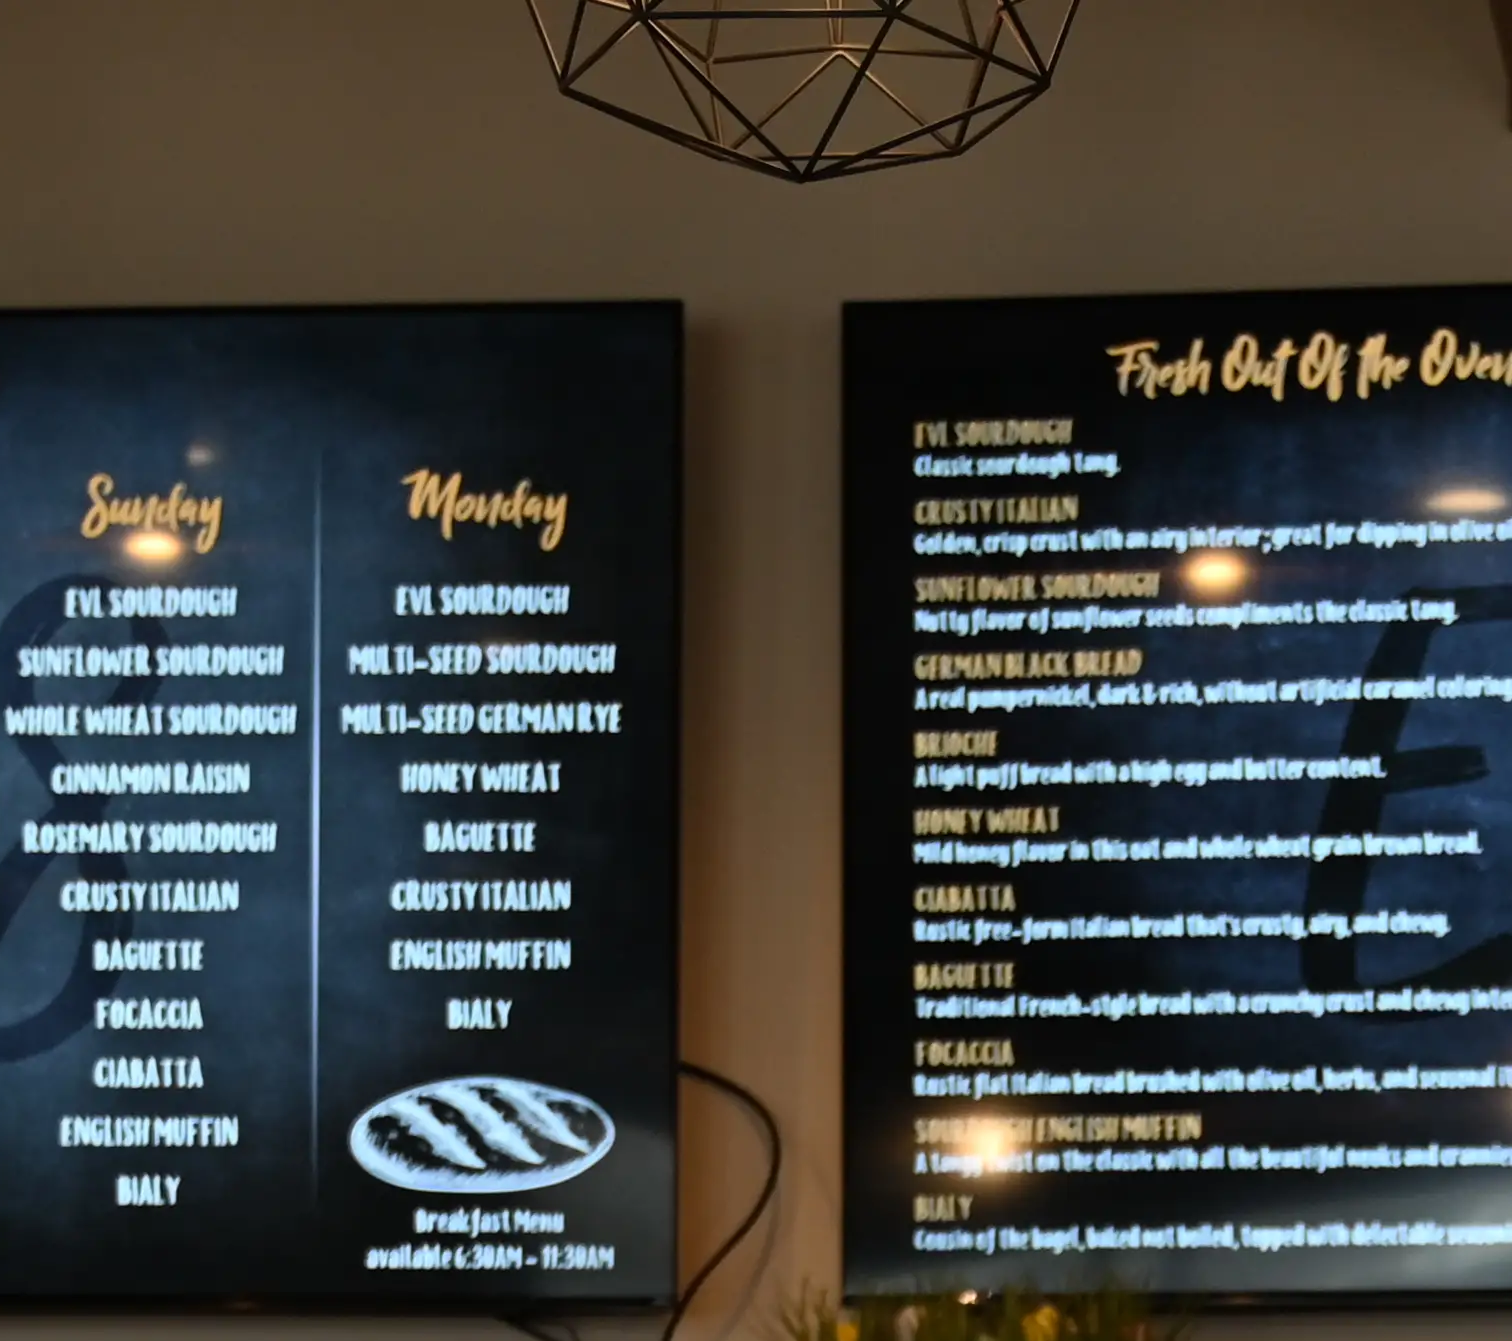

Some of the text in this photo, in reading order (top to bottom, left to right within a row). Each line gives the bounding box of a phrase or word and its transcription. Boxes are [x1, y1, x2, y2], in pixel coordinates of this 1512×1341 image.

[1105, 338, 1212, 399] Fresh
[1221, 334, 1297, 402] Out
[1298, 330, 1349, 402] Of
[81, 472, 223, 555] Sunday
[400, 467, 569, 552] Monday
[65, 586, 238, 619] EVL SOURDOUGH
[395, 583, 570, 616] EVL SOURDOUGH
[18, 644, 285, 678] SUNFLOWER SOURDOUGH
[348, 642, 617, 675] MULTI-SEED SOURDOUGH
[5, 703, 298, 736] WHOLE WHEAT SOURDOUGH
[340, 701, 621, 734] MULTI-SEED GERMAN RYE
[51, 762, 251, 795] CINNAMON RAISIN
[400, 761, 561, 793] HONEY WHEAT
[22, 820, 278, 854] ROSEMARY SOURDOUGH
[424, 820, 536, 853] BAGUETTE
[60, 880, 240, 912] CRUSTY ITALIAN
[390, 879, 572, 911] CRUSTY ITALIAN
[93, 939, 204, 971] BAGUETTE
[390, 939, 572, 971] ENGLISH MUFFIN
[95, 997, 204, 1030] FOCACCIA
[447, 997, 512, 1030] BIALY
[93, 1056, 204, 1089] CIABATTA
[59, 1115, 239, 1147] ENGLISH MUFFIN
[116, 1174, 181, 1206] BIALY
